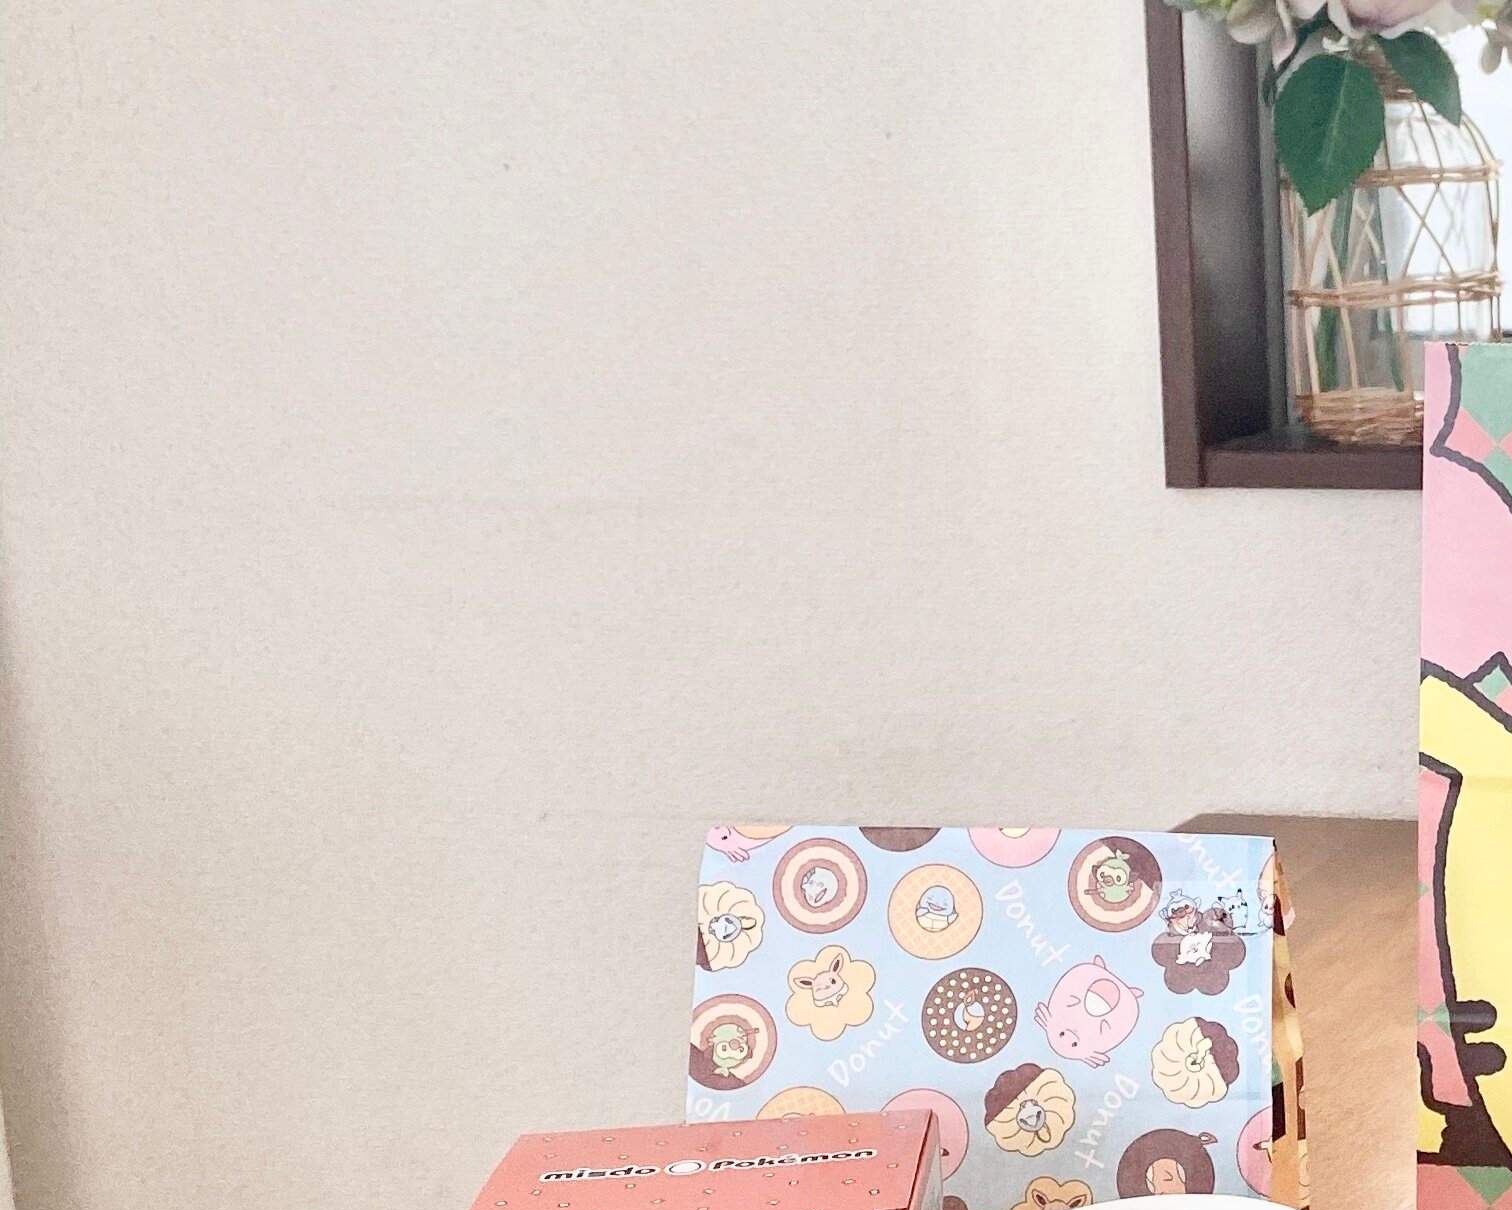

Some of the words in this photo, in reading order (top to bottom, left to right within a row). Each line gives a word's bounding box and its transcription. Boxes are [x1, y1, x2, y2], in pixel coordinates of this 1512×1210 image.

[1176, 835, 1244, 890] nut
[993, 879, 1072, 968] Donut
[826, 998, 910, 1088] Donut
[543, 1165, 656, 1181] misdo
[712, 1149, 874, 1171] Pokémon
[1075, 1072, 1140, 1171] Donut
